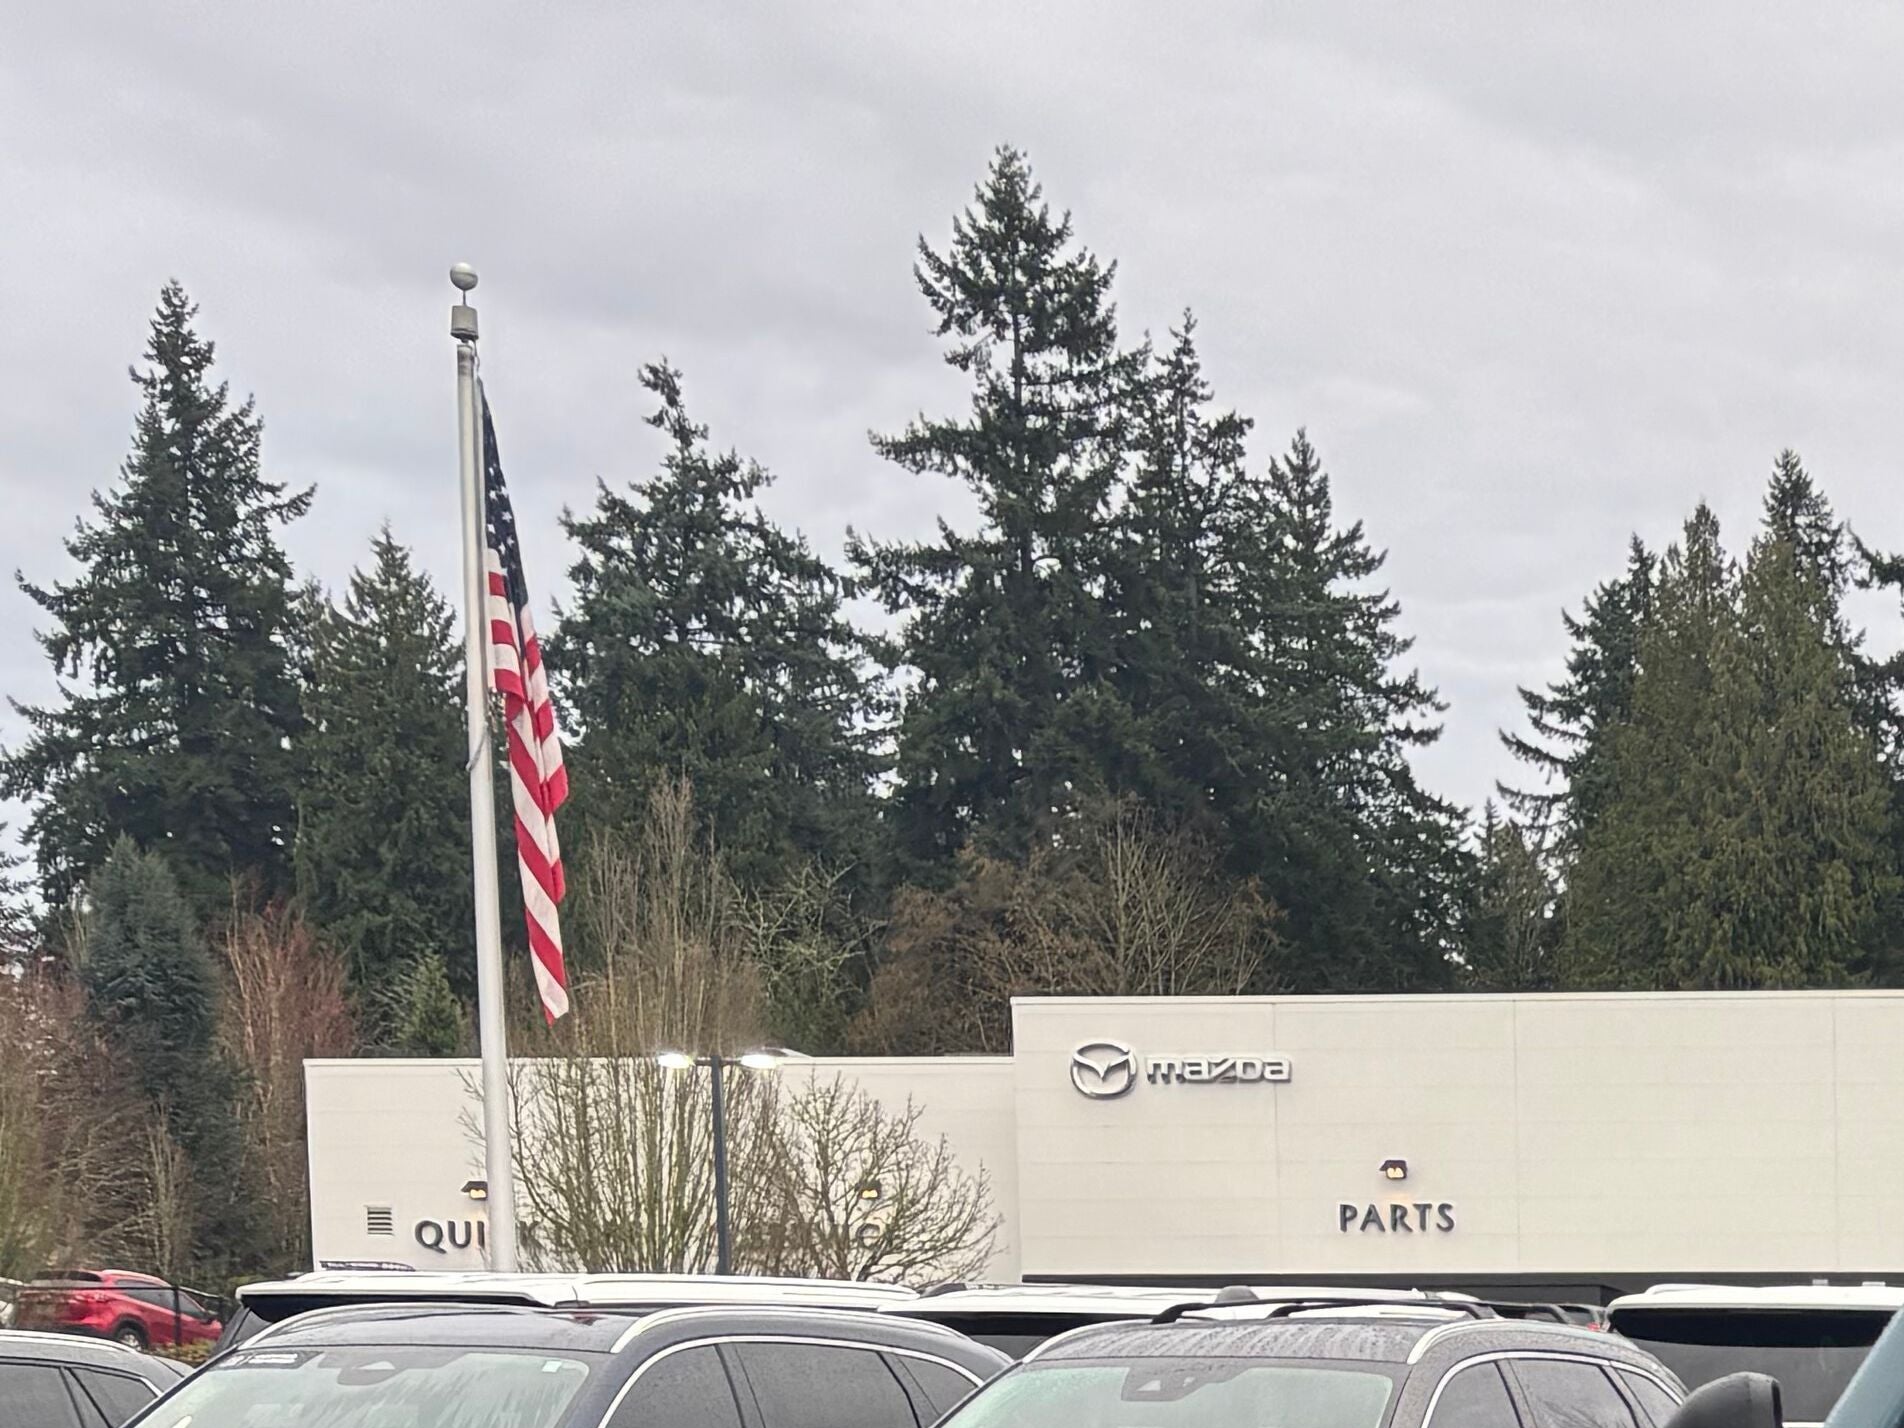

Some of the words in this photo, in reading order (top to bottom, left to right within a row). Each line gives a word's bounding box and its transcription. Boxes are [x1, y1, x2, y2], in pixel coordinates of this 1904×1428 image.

[1147, 1056, 1291, 1084] mazda
[1339, 1202, 1455, 1233] PARTS
[414, 1219, 546, 1254] QUIK
